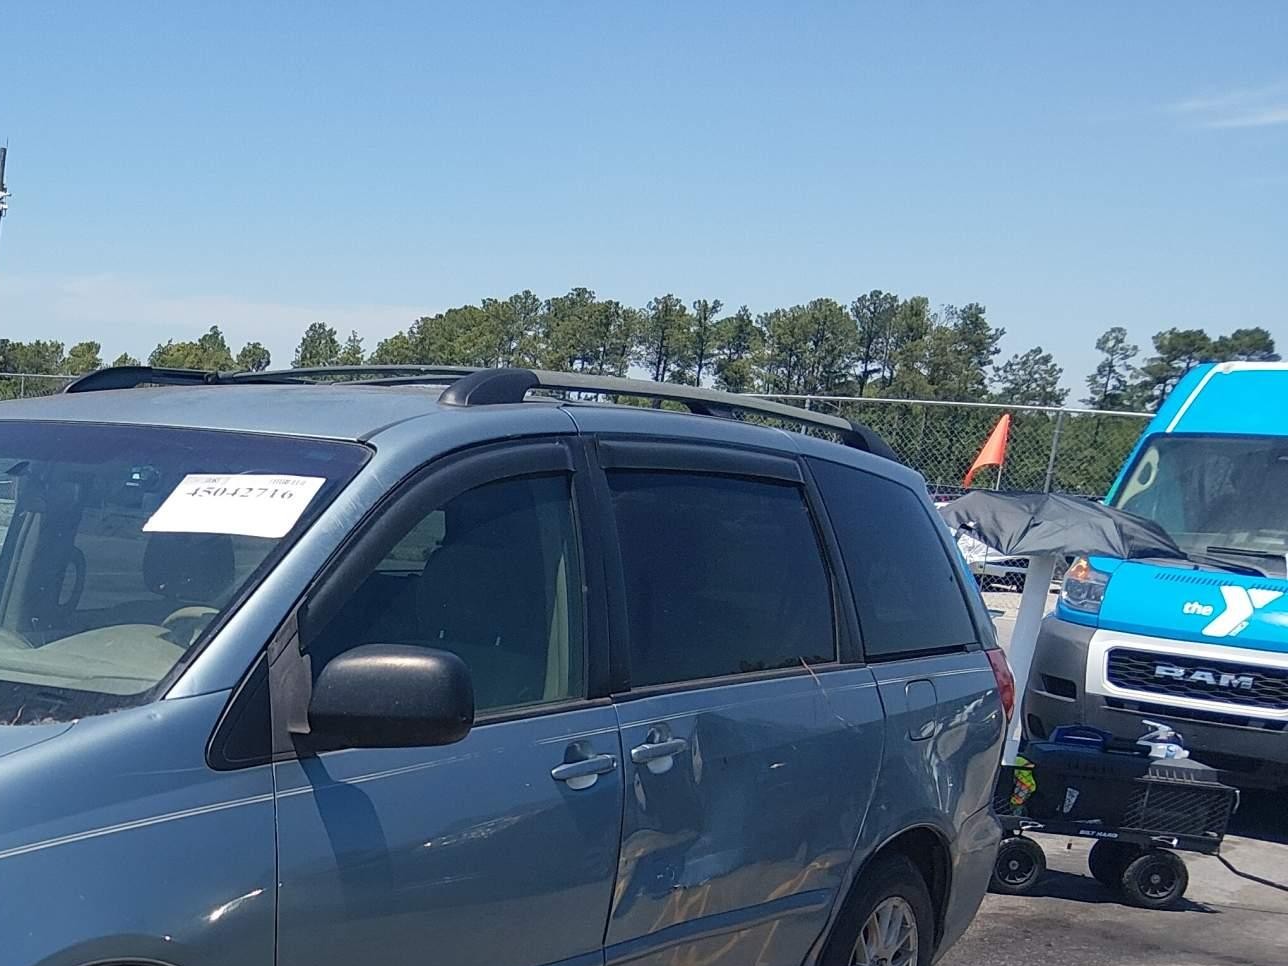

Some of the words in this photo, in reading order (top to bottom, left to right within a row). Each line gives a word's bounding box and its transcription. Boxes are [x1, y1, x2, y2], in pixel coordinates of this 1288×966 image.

[185, 487, 294, 499] 45042716
[1182, 601, 1214, 617] the
[1154, 665, 1254, 689] RAM
